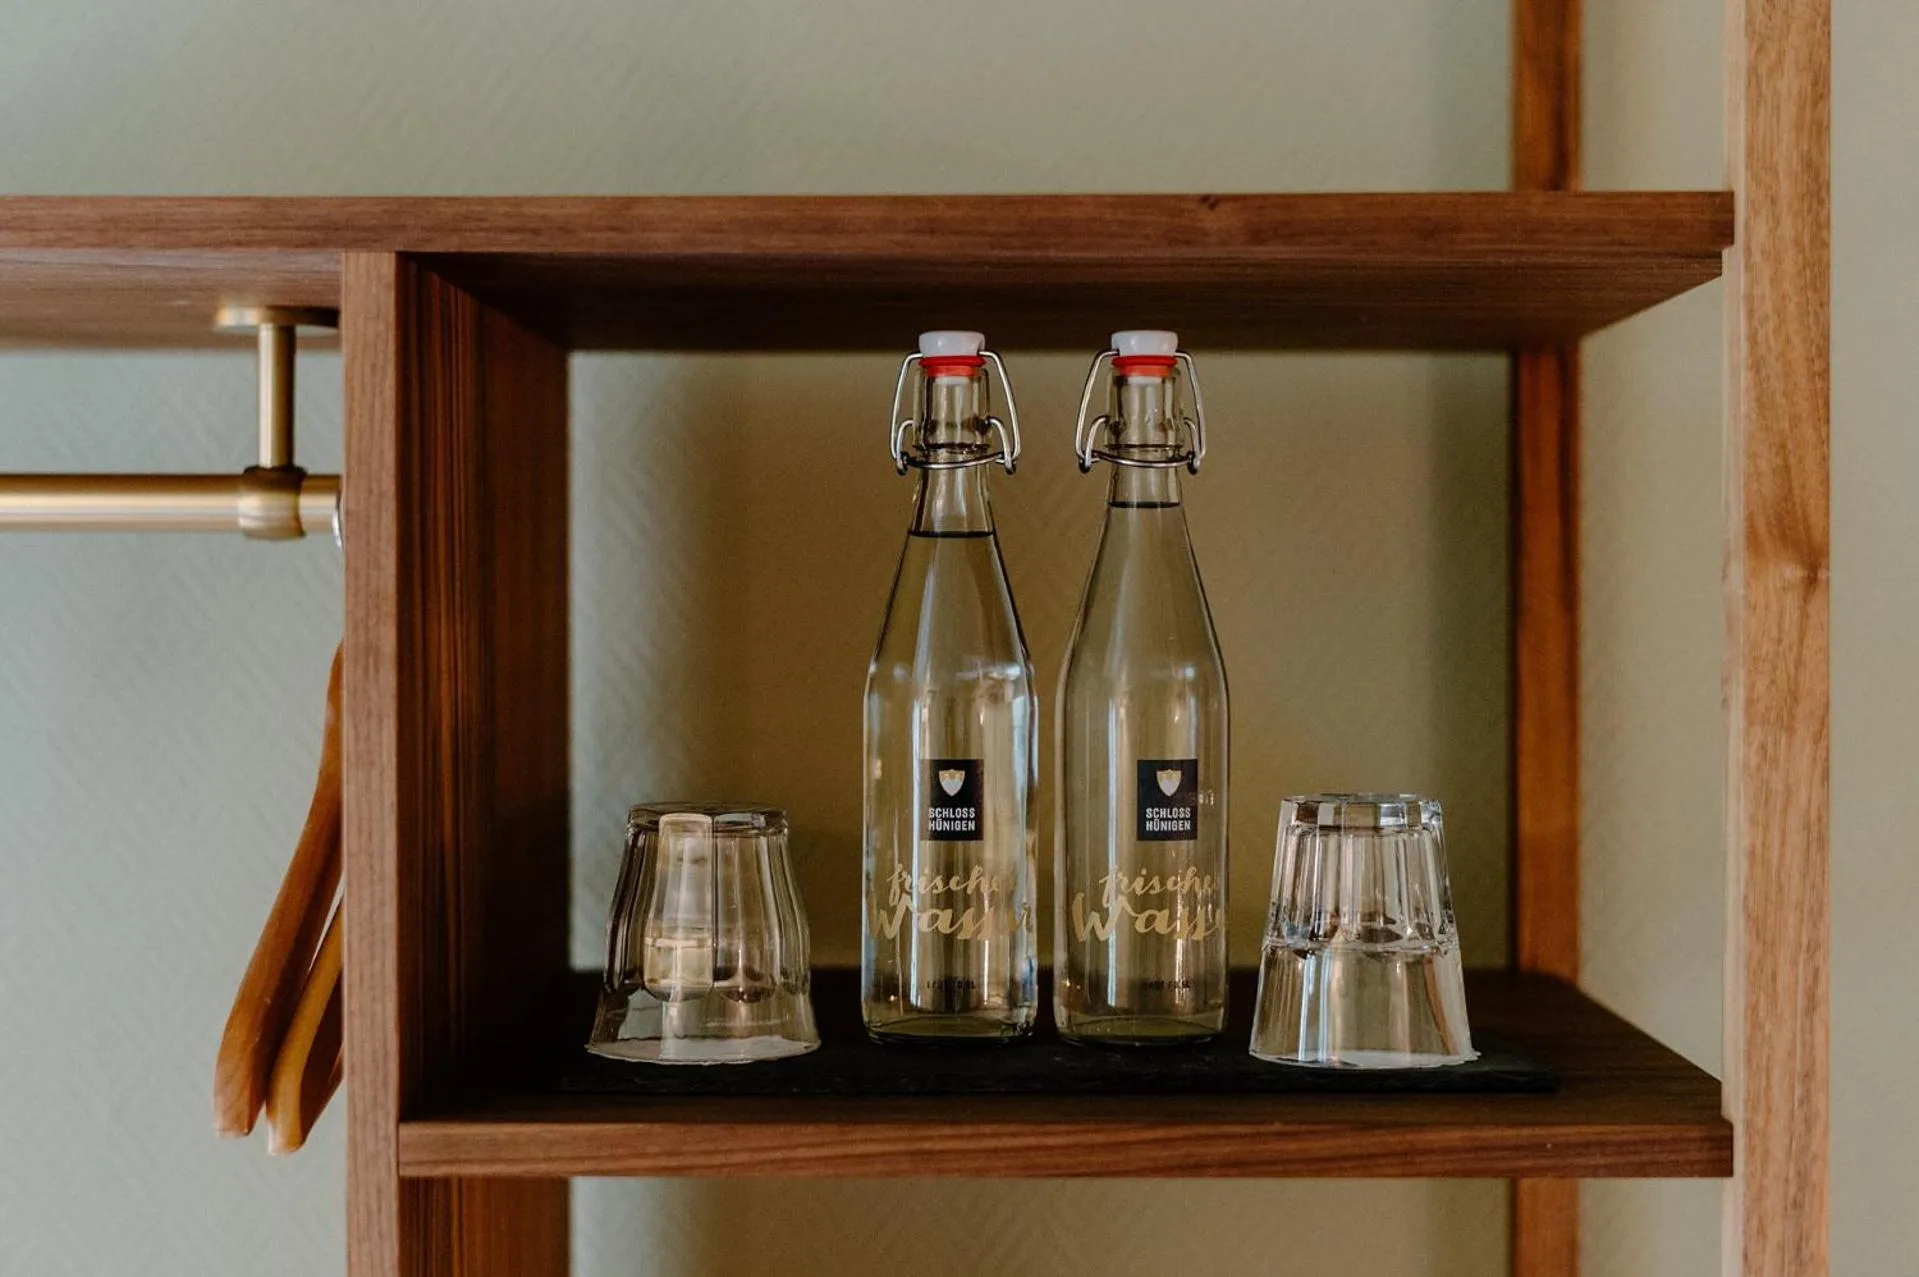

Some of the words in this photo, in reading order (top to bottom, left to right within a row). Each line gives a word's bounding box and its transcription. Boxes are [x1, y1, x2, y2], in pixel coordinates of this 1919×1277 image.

[928, 807, 976, 819] SCHLOSS
[1145, 807, 1191, 819] SCHLOSS
[928, 818, 976, 831] HÜNIGEN
[1145, 818, 1191, 832] HÜNIGEN
